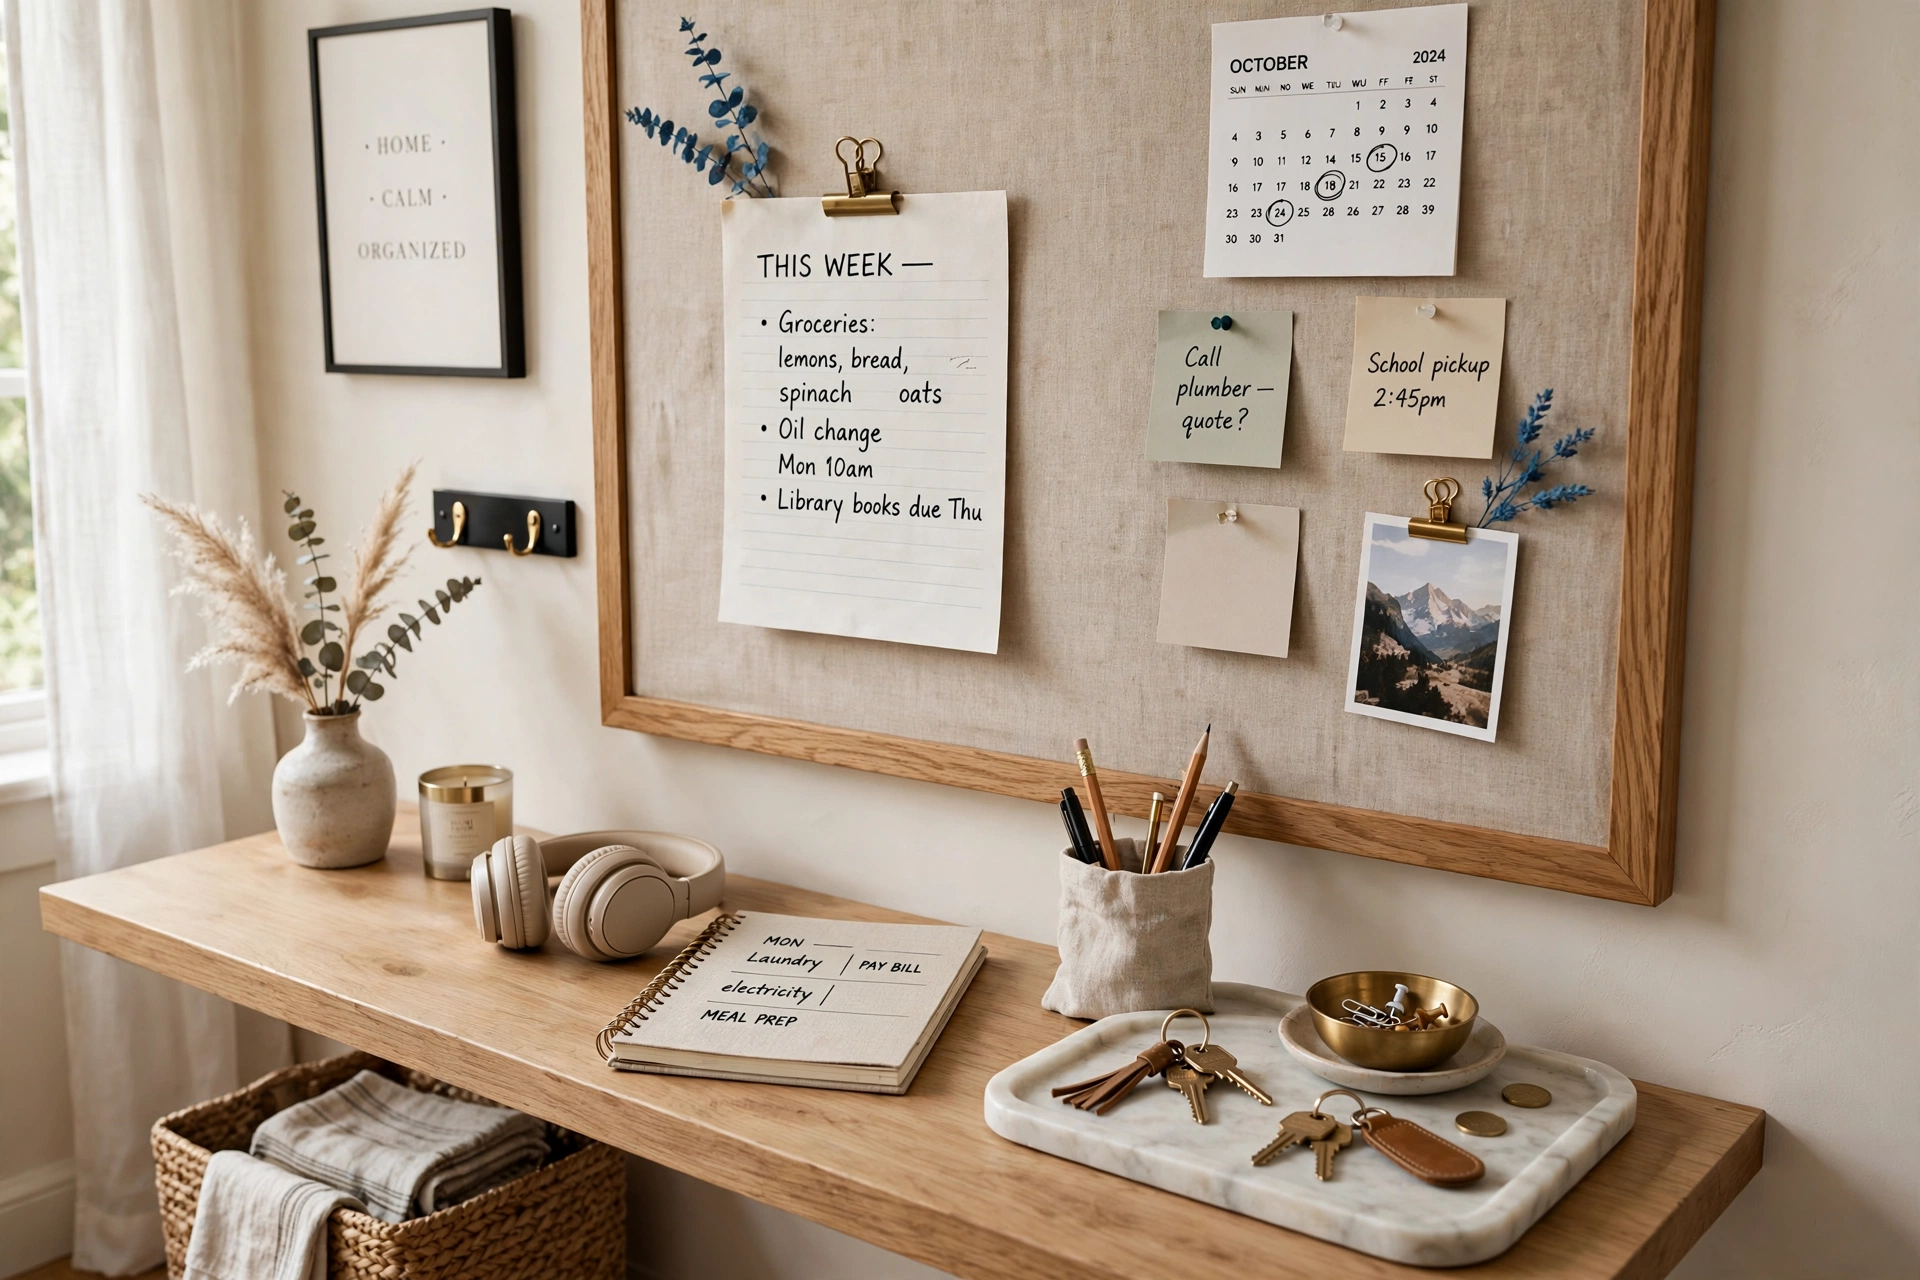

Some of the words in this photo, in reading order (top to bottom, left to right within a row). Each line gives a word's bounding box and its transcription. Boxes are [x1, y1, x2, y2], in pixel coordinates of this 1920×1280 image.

[1229, 54, 1309, 74] OCTOBER
[1412, 48, 1447, 64] 2024
[1301, 81, 1315, 90] WE
[1379, 99, 1387, 110] 2
[1404, 98, 1411, 109] 3
[1430, 97, 1437, 107] 4
[1231, 132, 1238, 142] 4
[1255, 130, 1262, 141] 3
[1280, 129, 1287, 140] 5
[1304, 129, 1312, 139] 6
[1329, 127, 1336, 138] 7
[1353, 126, 1361, 137] 8
[1378, 125, 1386, 136] 9
[1403, 124, 1411, 135] 9
[1426, 123, 1438, 134] 10
[377, 134, 432, 155] HOME
[1231, 157, 1239, 167] 9
[1253, 156, 1264, 167] 10
[1277, 156, 1286, 166] 11
[1301, 155, 1312, 165] 12
[1325, 154, 1336, 165] 14
[1350, 152, 1362, 164] 15
[1375, 152, 1387, 163] 15
[1400, 152, 1411, 162] 16
[1426, 150, 1437, 161] 17
[1228, 183, 1239, 193] 16
[1252, 182, 1263, 192] 17
[1276, 181, 1287, 192] 17
[1300, 181, 1311, 191] 18
[1325, 180, 1337, 191] 18
[1348, 179, 1360, 190] 21
[1372, 178, 1386, 189] 22
[1397, 177, 1411, 189] 23
[1423, 177, 1436, 188] 22
[381, 188, 432, 208] CALM
[1226, 208, 1239, 219] 23
[1250, 208, 1263, 218] 23
[1274, 207, 1286, 218] 24
[1297, 207, 1310, 218] 25
[1322, 206, 1335, 217] 28
[1346, 206, 1360, 217] 26
[1371, 205, 1385, 216] 27
[1396, 204, 1410, 216] 28
[1421, 204, 1435, 215] 39
[1225, 234, 1238, 244] 30
[1249, 233, 1262, 244] 30
[1273, 233, 1284, 244] 31
[357, 241, 466, 260] ORGANIZED
[757, 254, 811, 278] THIS
[825, 253, 892, 277] WEEK
[779, 310, 874, 333] Groceries:
[779, 346, 842, 373] lemons,
[852, 346, 907, 374] bread,
[1186, 346, 1221, 367] Call
[1368, 352, 1424, 373] School
[1431, 353, 1489, 382] pickup
[780, 380, 851, 411] spinach
[900, 381, 941, 404] oats
[1176, 376, 1251, 405] plumber
[1374, 388, 1445, 416] 2:45pm
[779, 417, 803, 439] Oil
[815, 418, 881, 452] change
[779, 454, 815, 475] Mon
[827, 456, 873, 478] 10am
[779, 488, 843, 523] Library
[853, 492, 900, 516] books
[910, 494, 941, 518] due
[948, 498, 982, 521] Thu
[763, 936, 804, 947] MON
[747, 952, 822, 973] Laundry
[859, 961, 887, 970] PAY
[891, 963, 920, 973] BILL
[722, 980, 812, 1005] electricity
[700, 1010, 746, 1022] MEAL
[755, 1014, 797, 1026] PREP
